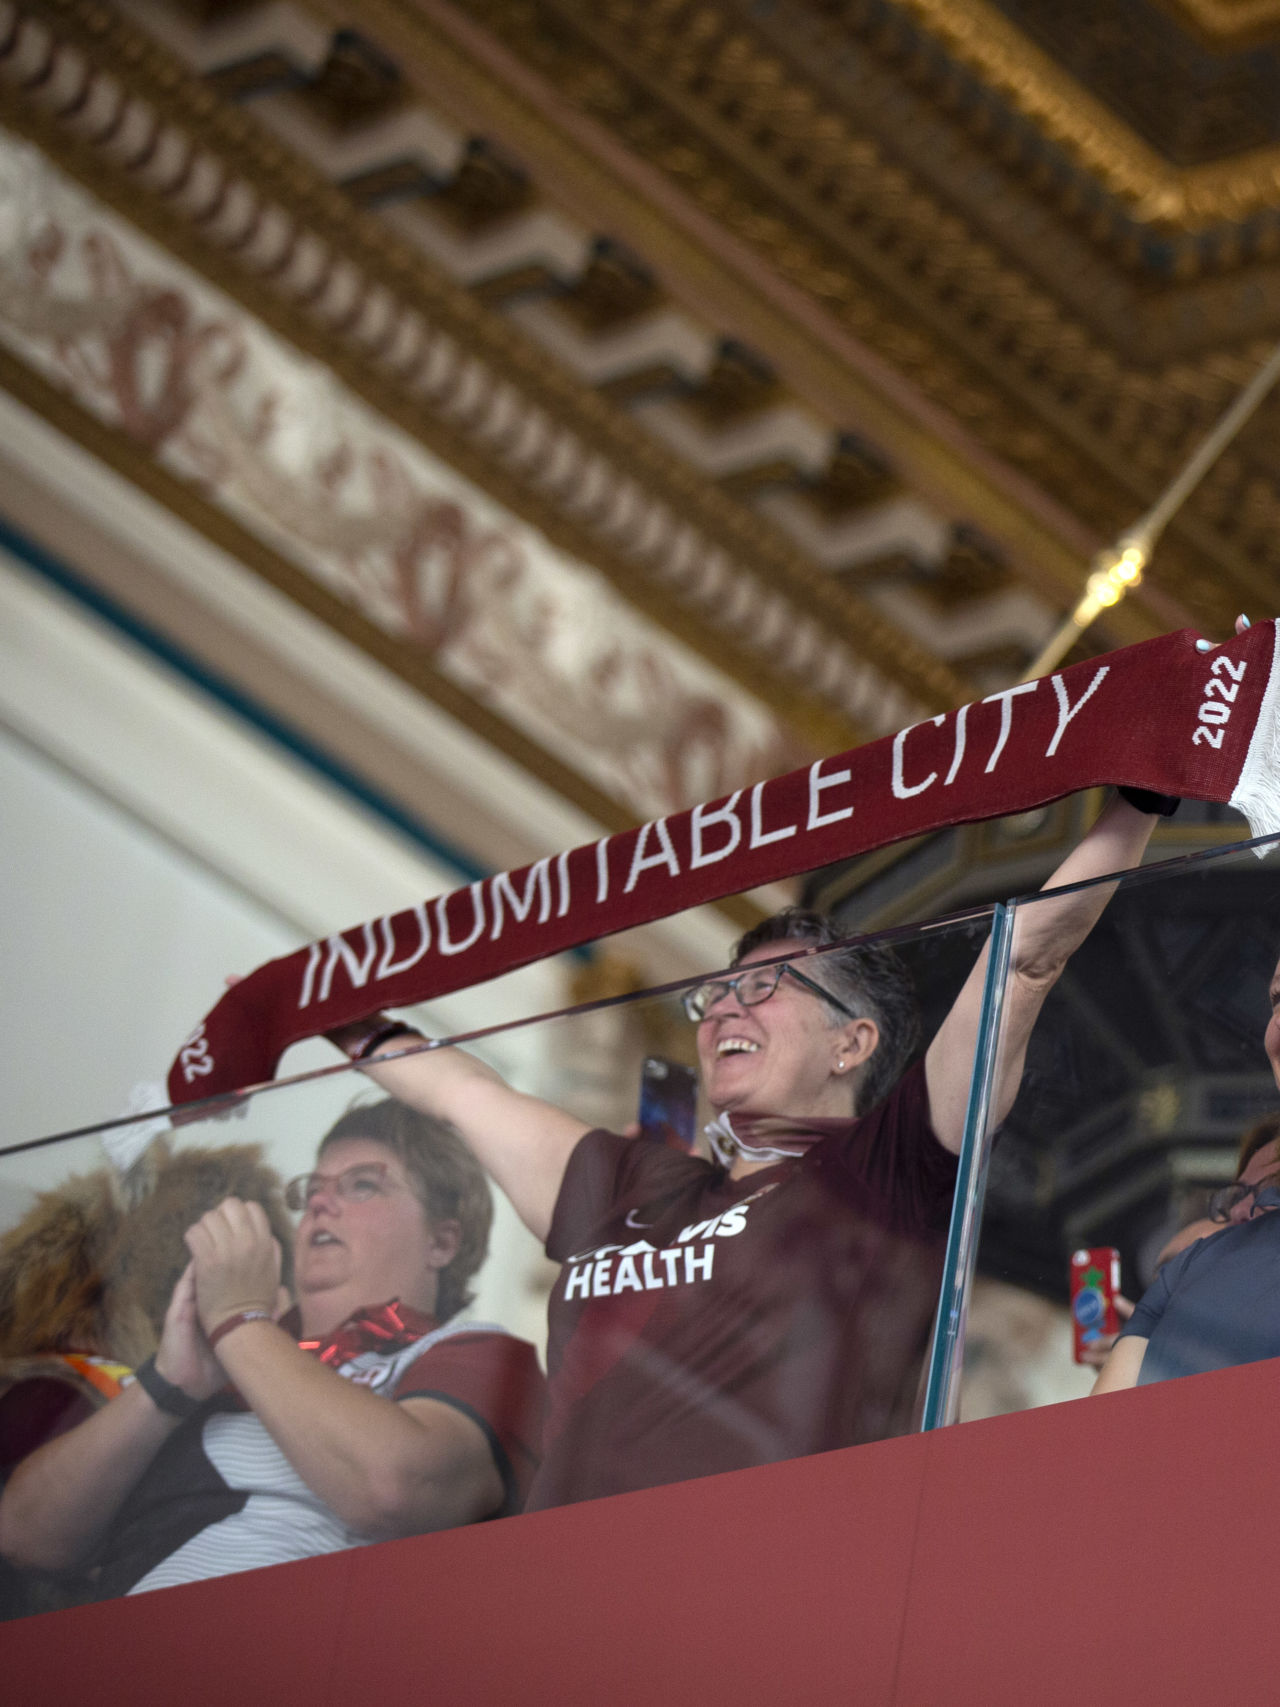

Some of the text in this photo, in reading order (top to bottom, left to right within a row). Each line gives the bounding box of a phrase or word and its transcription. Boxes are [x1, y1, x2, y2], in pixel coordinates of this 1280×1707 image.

[1192, 655, 1247, 750] 2022
[299, 666, 1110, 1009] INDOMITABLE CITY
[565, 1244, 715, 1301] HEALTH
